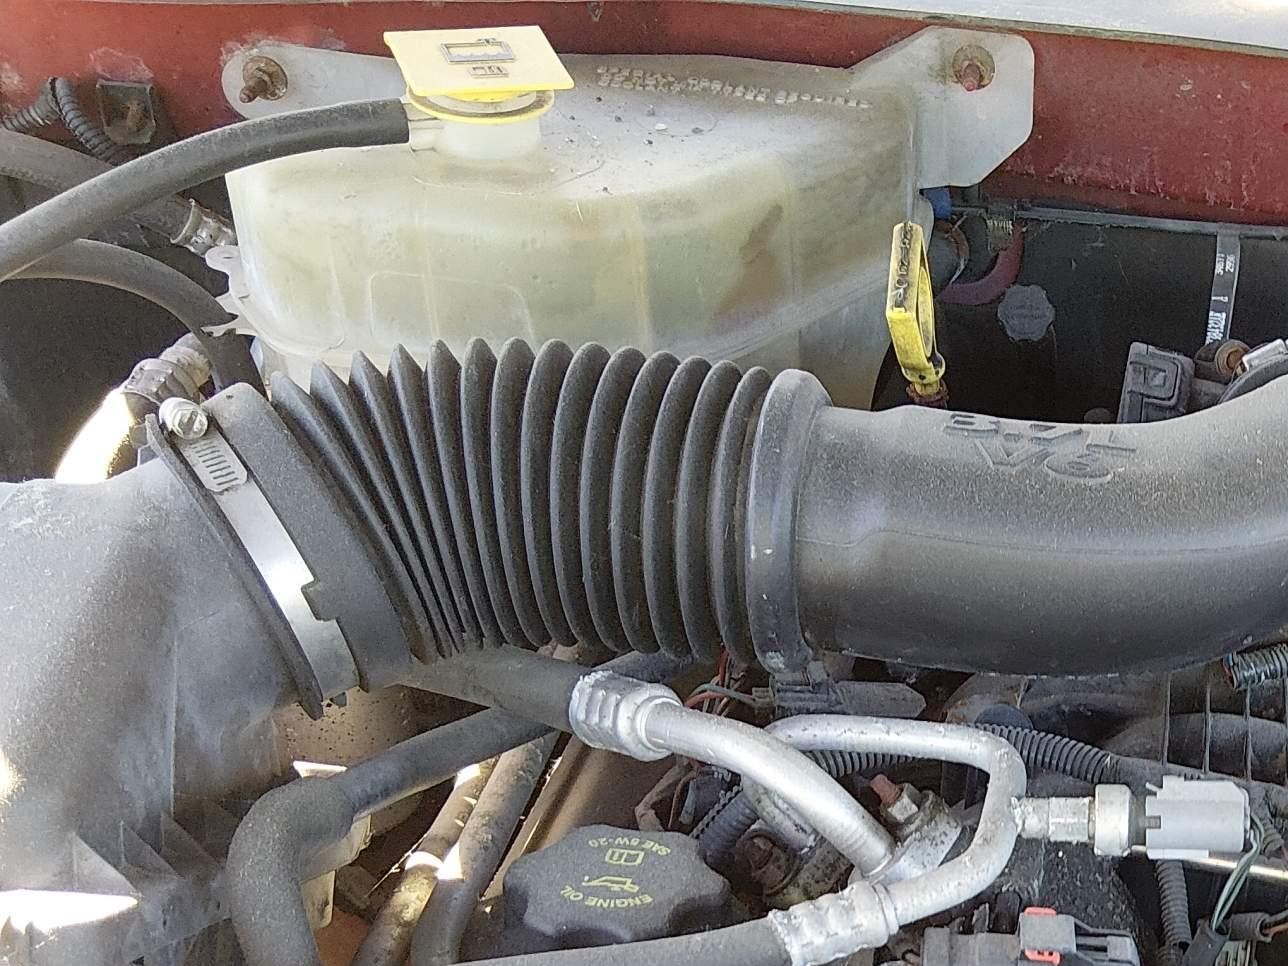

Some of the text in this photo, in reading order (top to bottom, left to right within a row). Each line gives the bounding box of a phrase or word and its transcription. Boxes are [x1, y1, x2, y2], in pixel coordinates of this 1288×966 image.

[974, 437, 1113, 483] V6
[641, 840, 671, 856] SAE
[560, 885, 654, 908] ENGINE OIL
